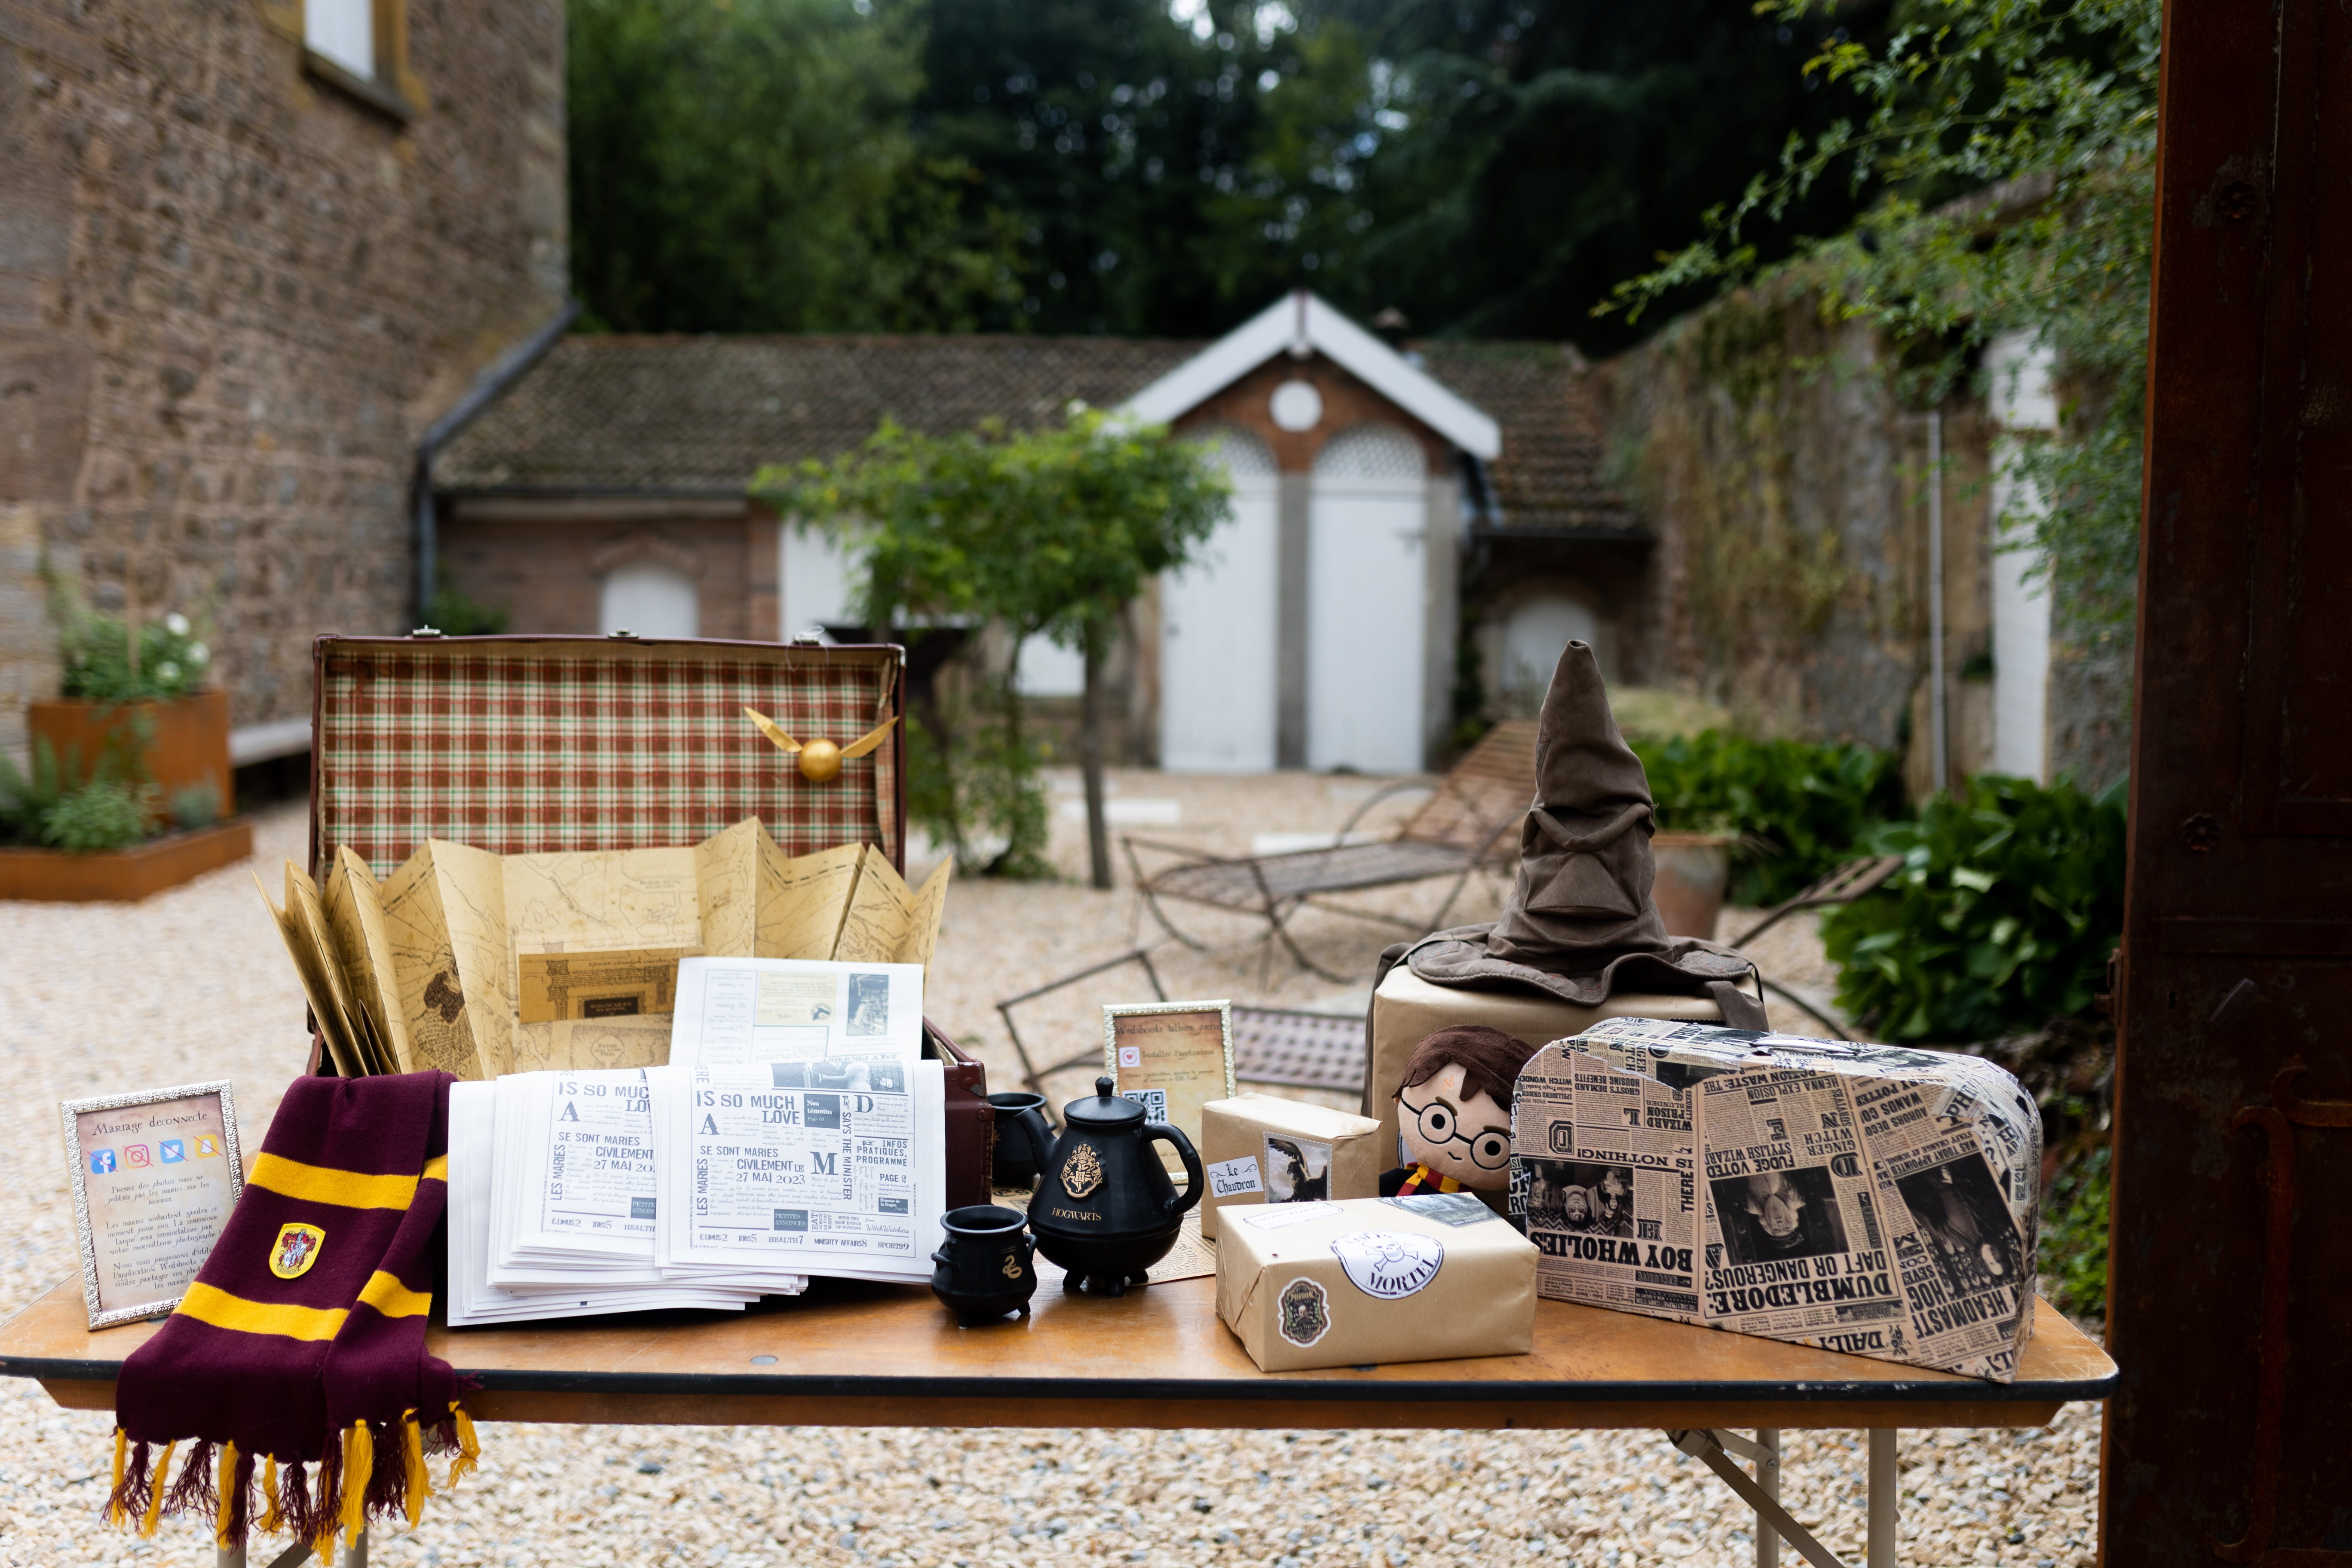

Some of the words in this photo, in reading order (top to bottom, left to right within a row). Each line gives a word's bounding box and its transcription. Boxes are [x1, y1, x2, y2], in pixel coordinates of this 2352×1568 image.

[1118, 1025, 1163, 1036] Wedshoots
[1549, 1077, 1572, 1085] WITCH
[1574, 1073, 1607, 1084] BENEFITS
[1609, 1076, 1640, 1087] HOUSING
[1725, 1075, 1768, 1089] WASTE:
[1804, 1077, 1839, 1091] HENNA
[559, 1082, 578, 1095] IS
[584, 1085, 606, 1096] SO
[615, 1086, 649, 1099] MUC
[1575, 1083, 1607, 1093] DEMAND
[1610, 1086, 1640, 1096] GHOST'S
[1704, 1081, 1723, 1093] THE
[1748, 1083, 1801, 1100] EXPLOSION
[697, 1090, 715, 1106] IS
[721, 1094, 742, 1107] SO
[751, 1095, 794, 1109] MUCH
[854, 1095, 874, 1113] D
[1646, 1099, 1684, 1109] BLUNDER
[1832, 1088, 1852, 1127] SURVIVES
[1880, 1092, 1923, 1116] WANDS
[762, 1110, 800, 1124] LOVE
[1647, 1106, 1685, 1119] PRISON
[1892, 1107, 1928, 1127] AURORS
[92, 1122, 143, 1136] Mariage
[150, 1111, 207, 1127] deconnecte
[842, 1112, 851, 1134] SAYS
[1647, 1117, 1693, 1131] WIZARD
[558, 1132, 571, 1141] SE
[576, 1133, 600, 1143] SONT
[605, 1136, 640, 1146] MARIES
[882, 1140, 907, 1148] INFOS
[1549, 1120, 1574, 1155] D
[1804, 1128, 1853, 1145] WITCH
[1951, 1131, 1973, 1144] STAFF
[596, 1147, 653, 1160] CIVILEMENT
[700, 1145, 712, 1155] SE
[717, 1146, 740, 1155] SONT
[745, 1148, 778, 1157] MARIES
[842, 1139, 851, 1154] THE
[857, 1146, 907, 1158] PRATIQUES,
[1746, 1142, 1792, 1159] STYLISH
[1807, 1139, 1856, 1156] GINGER
[1922, 1139, 1949, 1153] CHANGE
[1934, 1145, 1960, 1161] TODAY
[1959, 1140, 1978, 1152] WAS
[553, 1144, 566, 1179] MARIES
[810, 1152, 839, 1175] M
[856, 1155, 907, 1166] PROGRAMME
[1577, 1148, 1669, 1166] NOTHING!
[1675, 1158, 1694, 1169] IS
[1755, 1155, 1795, 1173] FUDGE
[1831, 1152, 1863, 1178] D
[1885, 1152, 1911, 1165] SCHOOL
[1891, 1154, 1932, 1175] APPOINTED
[594, 1160, 607, 1169] 27
[611, 1161, 631, 1171] MAI
[737, 1159, 793, 1171] CIVILEMENT
[795, 1164, 804, 1172] LE
[1226, 1163, 1238, 1177] Le
[1706, 1161, 1751, 1179] VOTED
[697, 1158, 708, 1194] MARIES
[736, 1173, 748, 1182] 27
[753, 1172, 772, 1183] MAI
[776, 1175, 805, 1185] 2023
[843, 1156, 852, 1200] MINISTER
[880, 1174, 898, 1182] PAGE
[902, 1175, 906, 1183] 2
[112, 1185, 135, 1194] Prenez
[152, 1179, 175, 1190] photos
[550, 1182, 562, 1200] LES
[1217, 1179, 1256, 1196] Chaudron
[1681, 1170, 1694, 1213] THERE
[104, 1194, 131, 1207] publiez
[131, 1193, 145, 1203] pas
[148, 1197, 172, 1205] reseaux
[697, 1197, 707, 1216] LES
[122, 1219, 144, 1227] maries
[148, 1210, 181, 1222] souhaitent
[186, 1207, 208, 1218] garder
[1052, 1207, 1102, 1221] HOGWARTS
[107, 1227, 134, 1238] moment
[135, 1226, 154, 1237] pour
[187, 1215, 218, 1225] ceremonie
[110, 1247, 129, 1255] notre
[133, 1240, 172, 1251] merveilleuse
[172, 1231, 216, 1247] photographe
[116, 1237, 135, 1247] laique
[157, 1227, 198, 1238] immortalisee
[197, 1225, 212, 1234] par
[150, 1253, 188, 1267] proposons
[1645, 1244, 1693, 1273] BOY
[1813, 1256, 1838, 1277] OR
[1845, 1250, 1888, 1274] DAFT
[113, 1268, 155, 1281] l'application
[160, 1259, 196, 1270] Wedshoots
[1366, 1259, 1437, 1292] MORTEL
[1704, 1259, 1811, 1290] DANGEROUS?
[115, 1279, 136, 1287] voulez
[136, 1274, 168, 1287] partagez
[1637, 1271, 1678, 1286] EXCLUSIVE
[1290, 1292, 1315, 1302] POISON
[1706, 1273, 1893, 1315] DUMBLEDORE:
[1912, 1289, 2009, 1340] HEADMASTE
